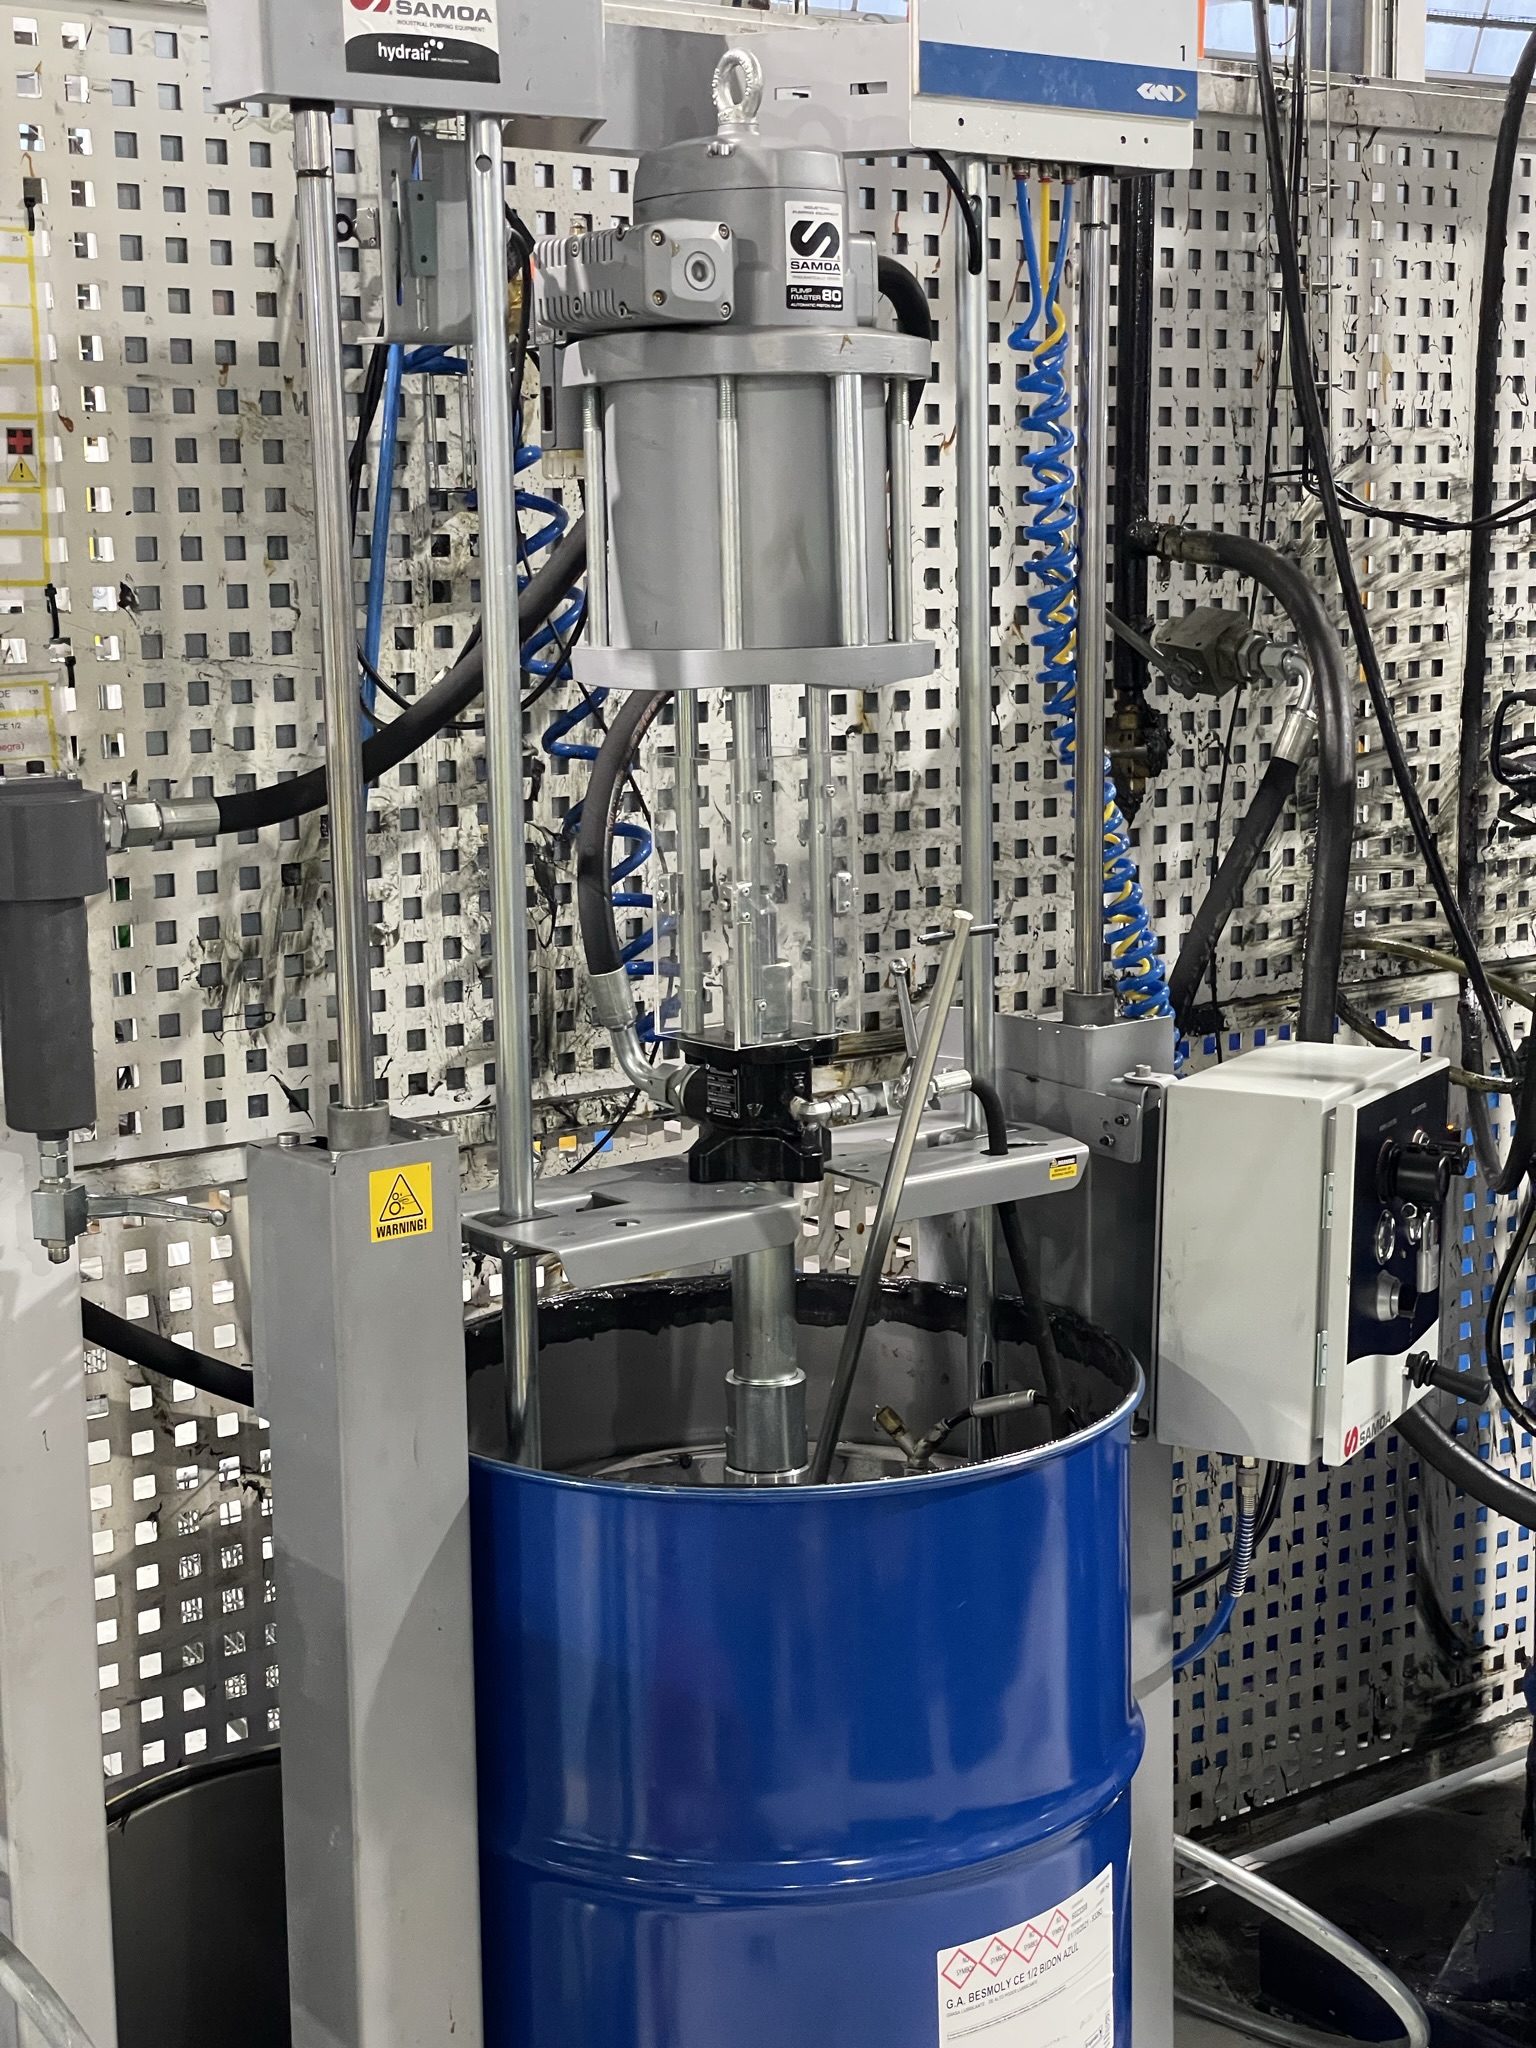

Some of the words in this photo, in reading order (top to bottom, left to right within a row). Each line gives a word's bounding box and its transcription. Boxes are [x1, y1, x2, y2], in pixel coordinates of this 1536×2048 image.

[396, 0, 492, 23] SAMOA
[378, 41, 431, 61] hydrair
[1180, 44, 1186, 62] 1
[790, 260, 841, 272] SAMOA
[821, 288, 842, 302] 80
[376, 1218, 428, 1238] WARNING!
[1360, 1411, 1391, 1446] SAMOA
[946, 1996, 966, 2009] G.A.
[968, 1978, 1011, 2003] BESMOLY
[1013, 1973, 1025, 1985] CE
[1027, 1967, 1038, 1980] 1/2
[1040, 1953, 1062, 1974] BIDON
[1063, 1942, 1079, 1960] AZUL
